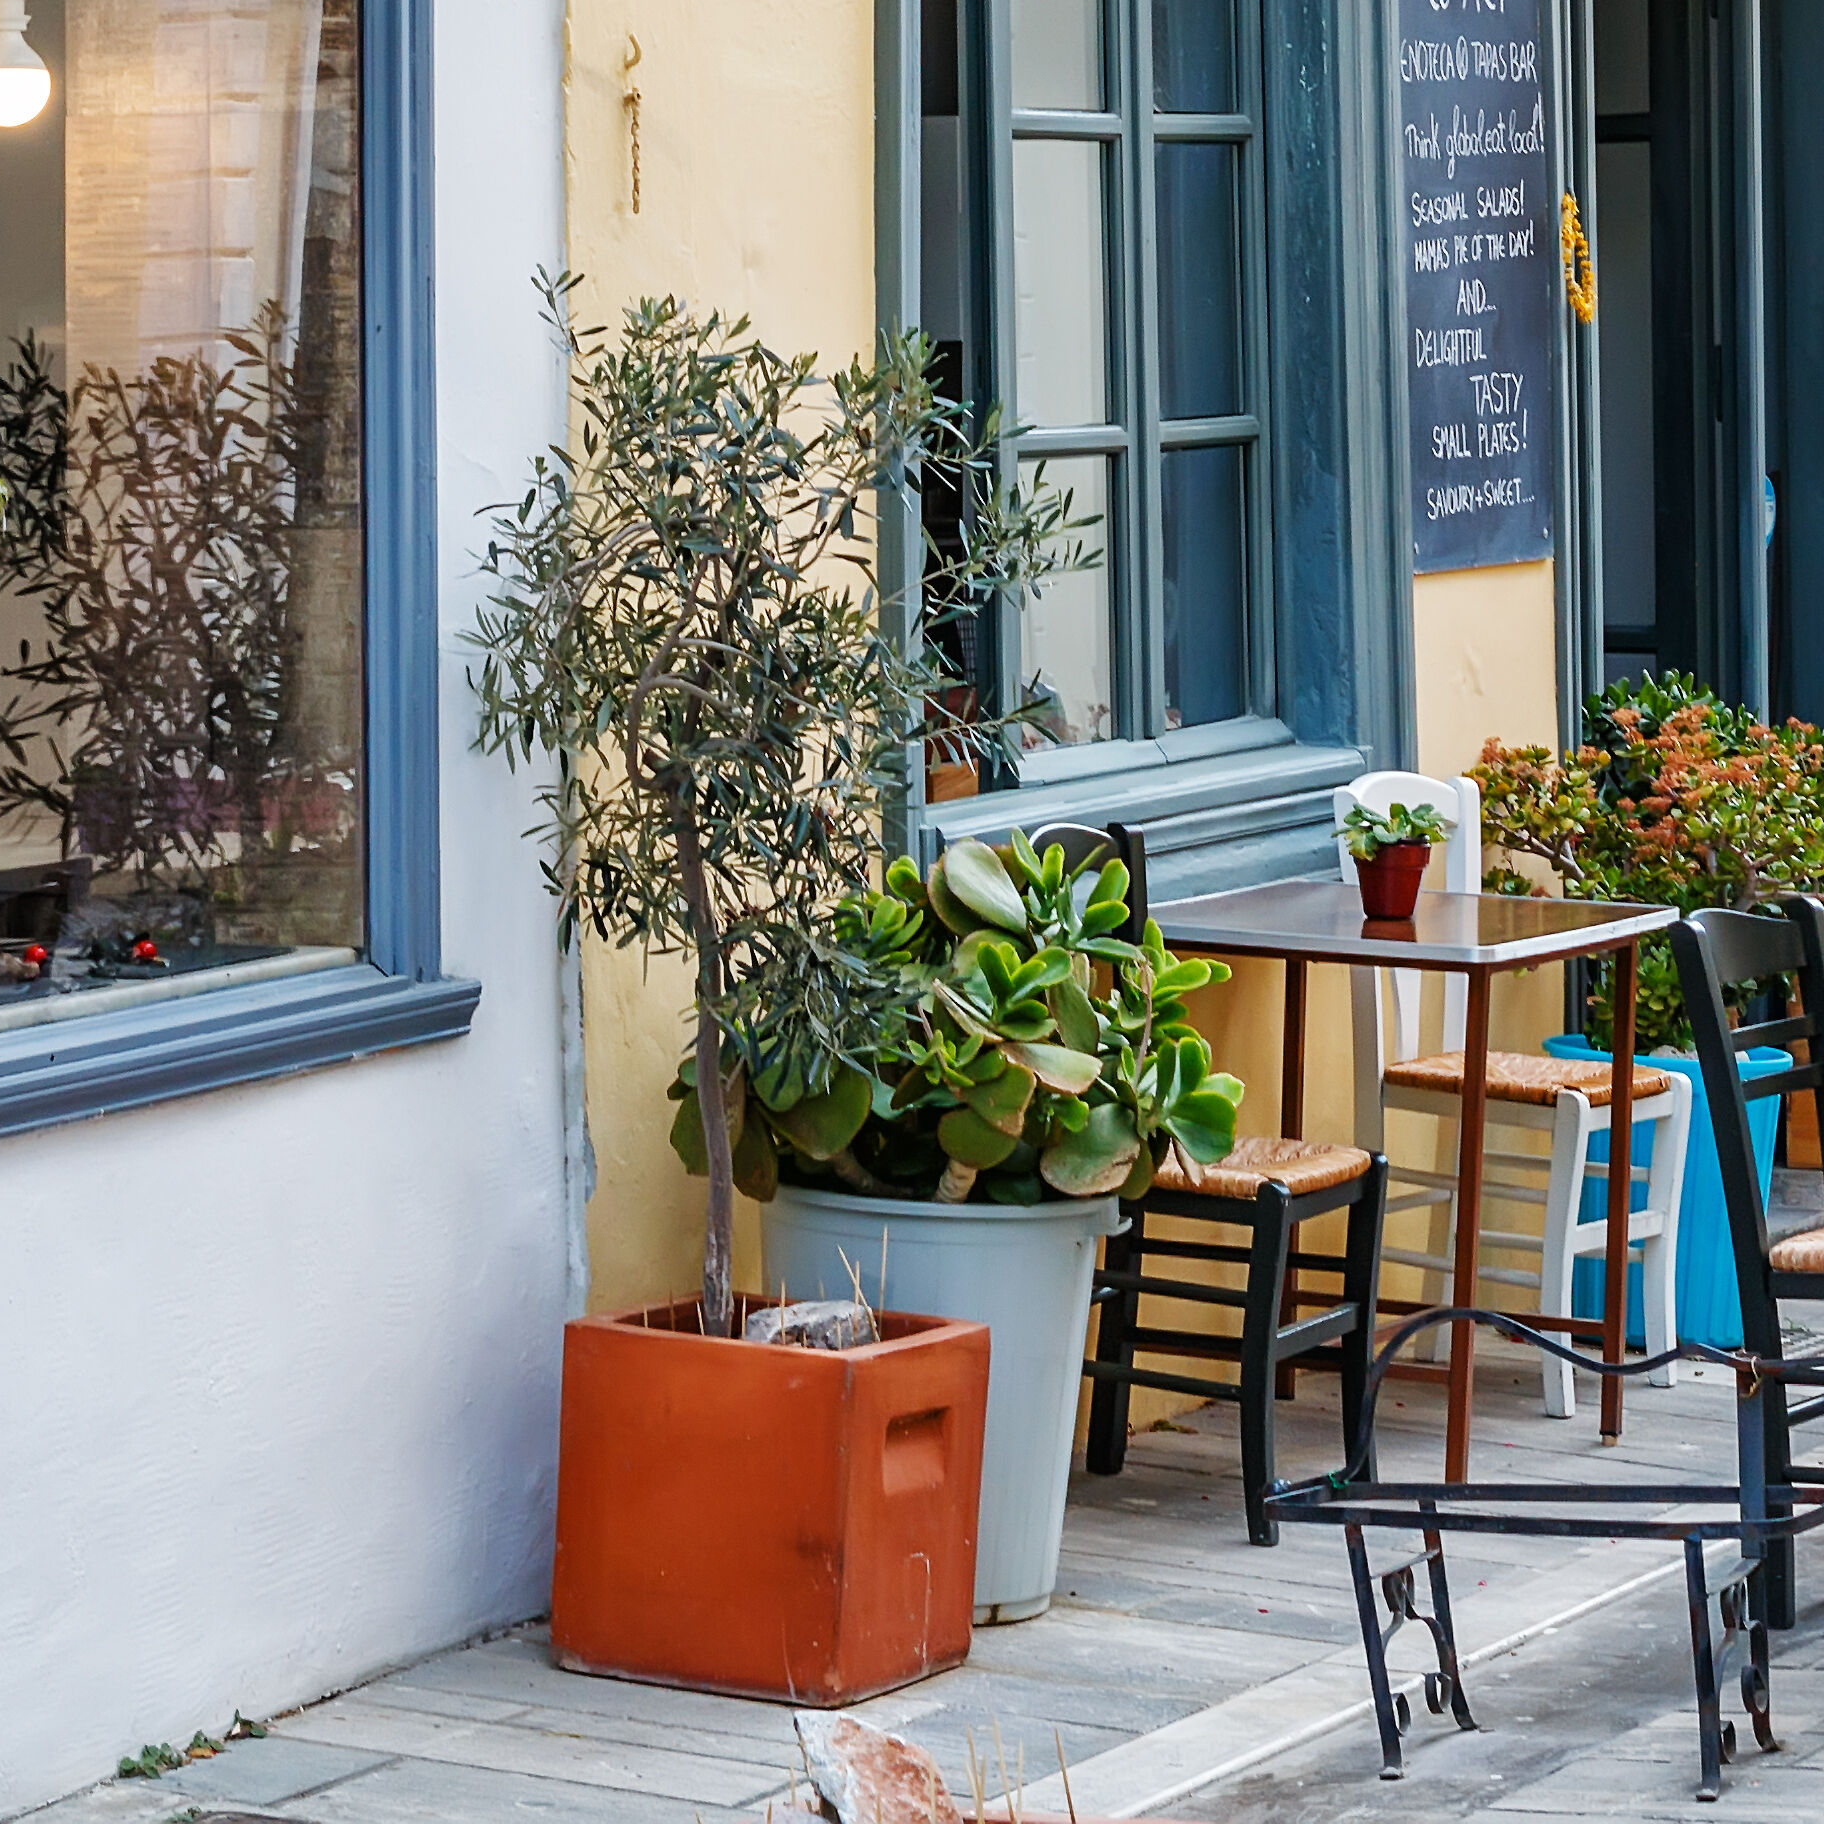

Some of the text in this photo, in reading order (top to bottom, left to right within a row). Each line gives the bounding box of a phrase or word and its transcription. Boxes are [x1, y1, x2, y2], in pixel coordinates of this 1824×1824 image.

[1400, 38, 1456, 82] ENOTECA
[1471, 41, 1508, 81] TAPAS
[1509, 40, 1538, 83] BAR
[1405, 112, 1441, 160] Think
[1411, 178, 1524, 228] SEASONAL SALADS!
[1454, 235, 1469, 266] PIE
[1471, 234, 1484, 262] OF
[1486, 233, 1506, 261] THE
[1508, 218, 1535, 259] DAY!
[1416, 328, 1487, 368] DELIGHTFUL
[1469, 371, 1524, 417] TASTY
[1432, 408, 1528, 461] SMALL PLATES!
